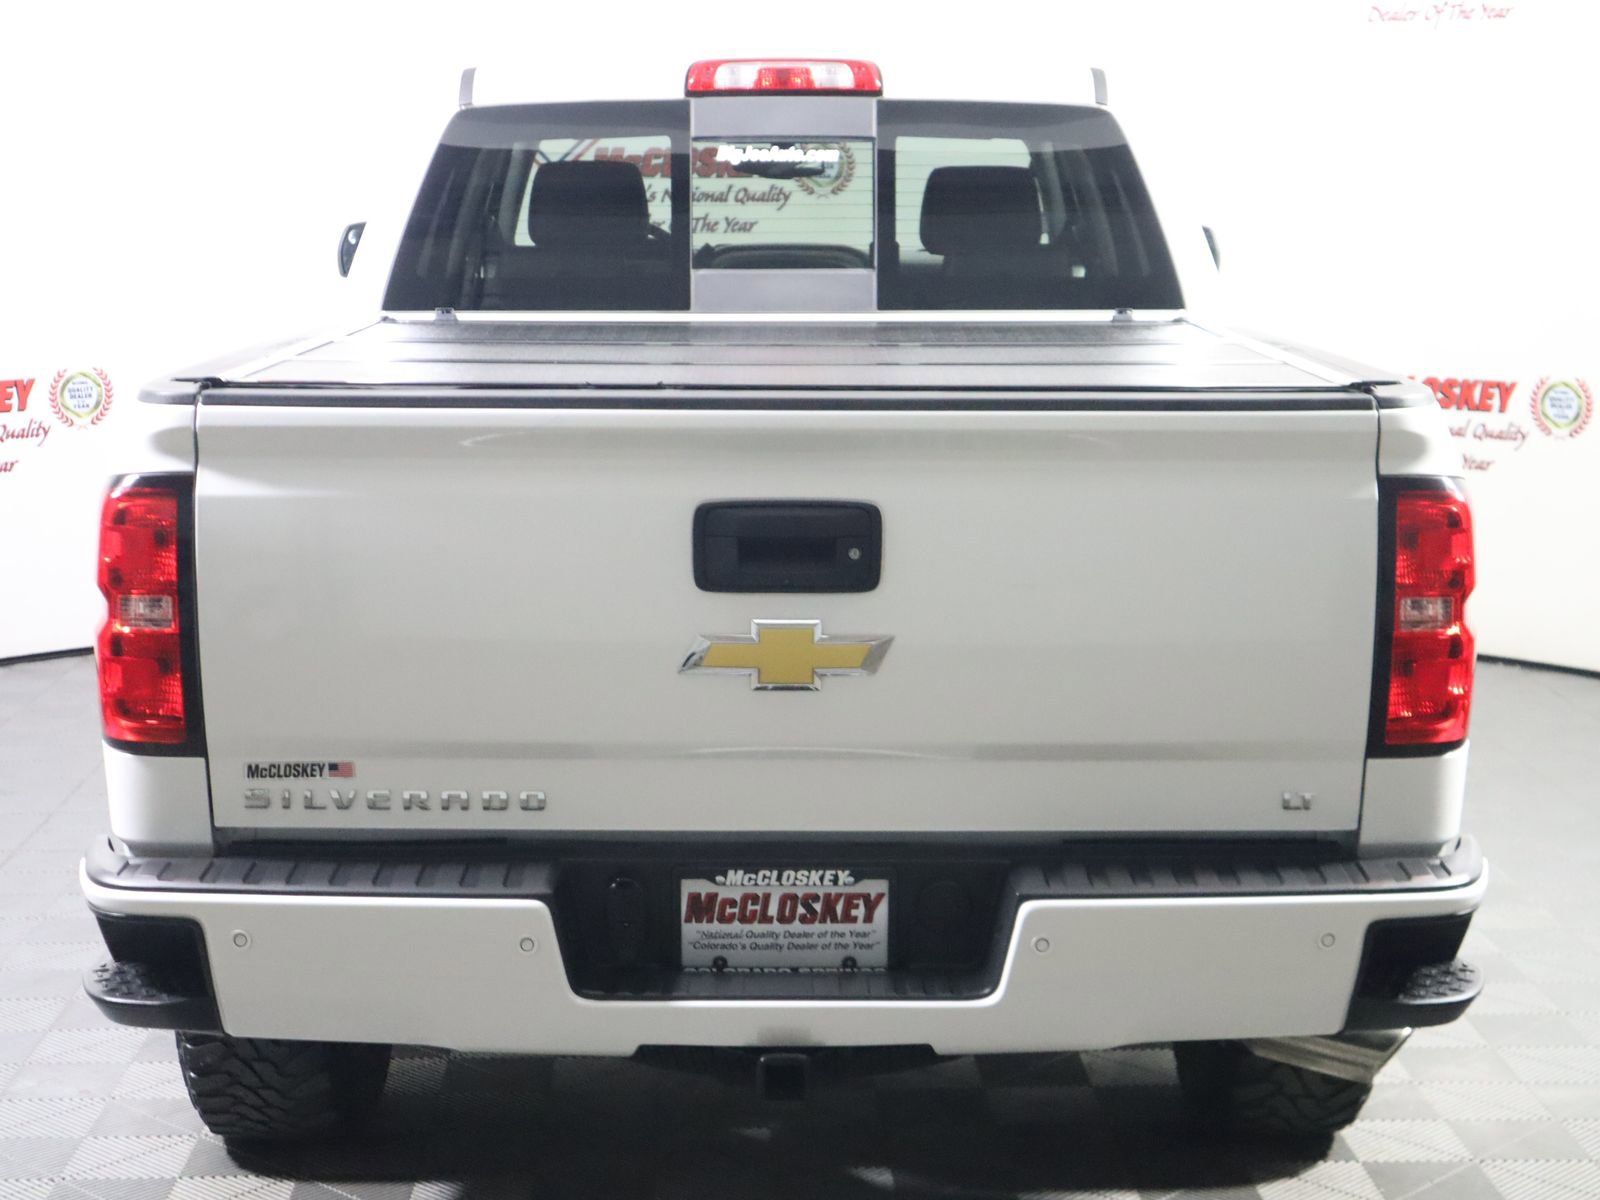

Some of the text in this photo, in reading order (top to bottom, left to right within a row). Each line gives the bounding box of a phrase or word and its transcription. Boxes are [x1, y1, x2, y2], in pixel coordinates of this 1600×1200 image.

[734, 184, 792, 211] Quality
[692, 212, 759, 233] The Year
[1473, 421, 1529, 451] Quality
[246, 763, 326, 779] McCLOSKEY
[244, 788, 547, 811] SILVERADO
[1282, 792, 1317, 810] LT
[725, 869, 850, 886] McCLOSKEY
[684, 892, 885, 925] McCLOSKEY
[746, 930, 780, 941] Quality
[783, 930, 814, 939] Dealer
[817, 930, 828, 939] of
[829, 930, 846, 939] the
[749, 942, 784, 952] Quality
[788, 942, 819, 951] Dealer
[821, 942, 832, 951] of
[833, 942, 850, 951] the
